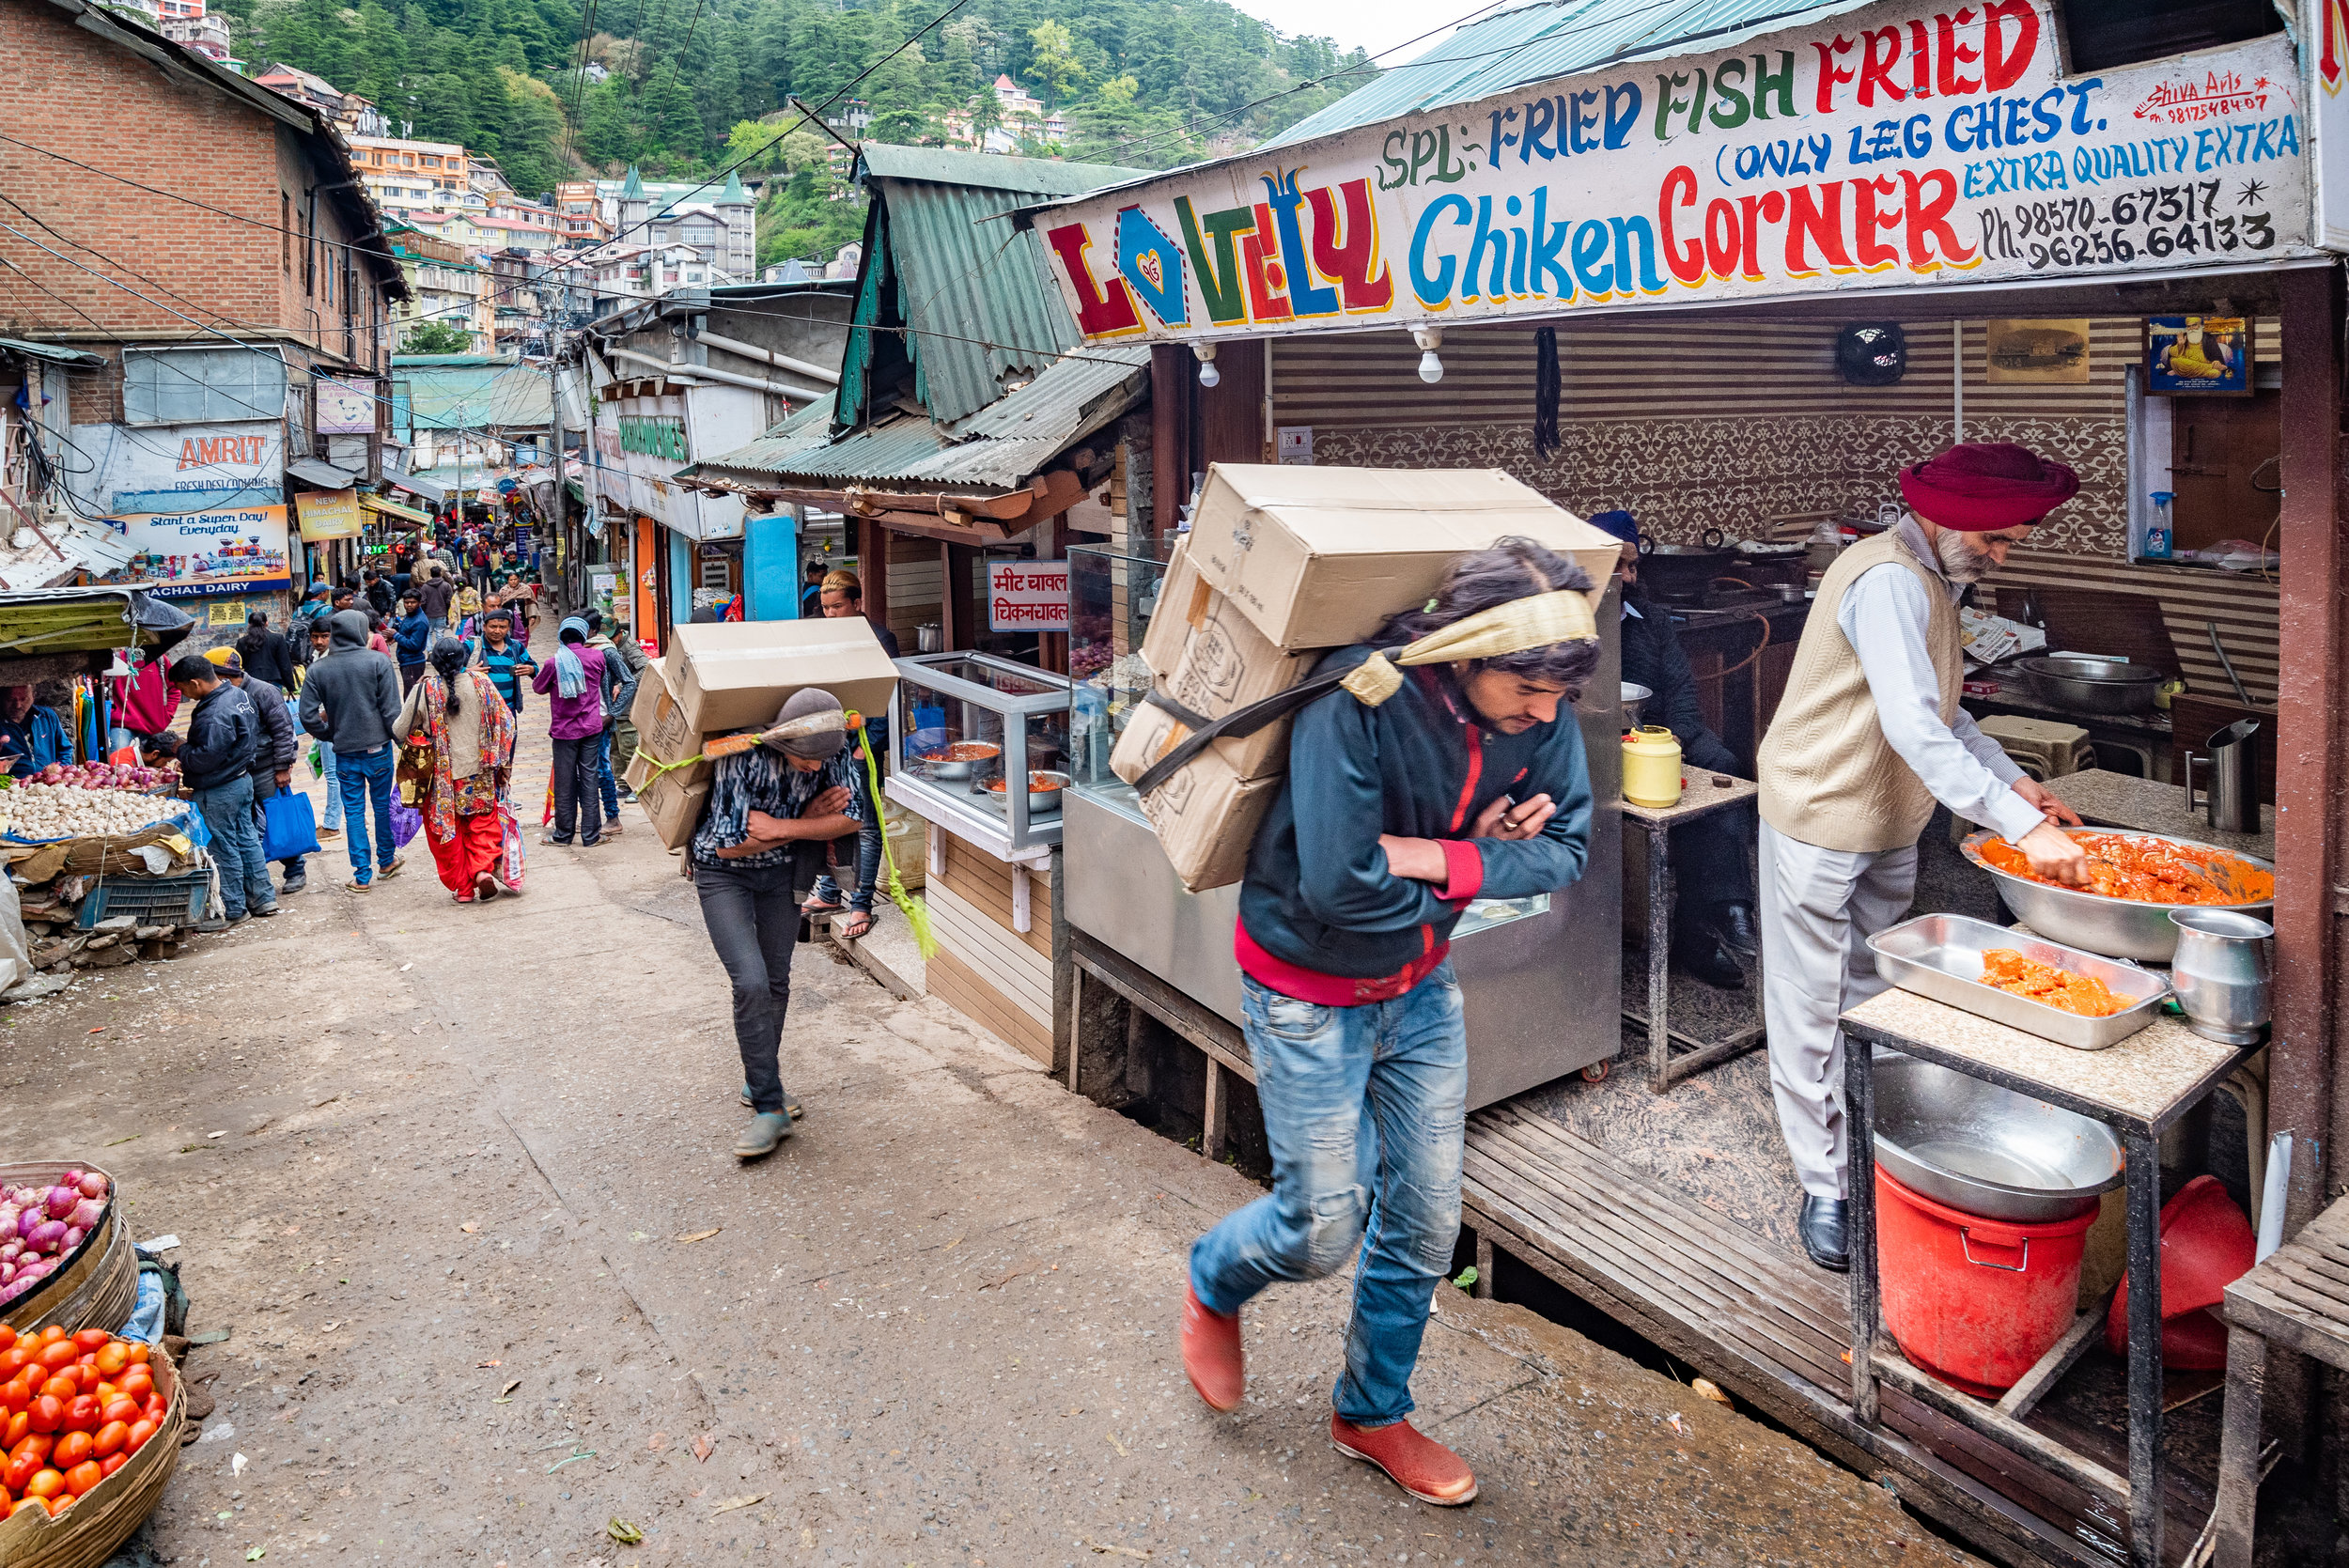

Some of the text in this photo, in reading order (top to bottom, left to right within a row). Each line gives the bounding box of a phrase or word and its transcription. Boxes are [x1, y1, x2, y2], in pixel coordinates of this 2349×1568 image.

[1487, 81, 1642, 169] FRIED
[1655, 49, 1800, 140] FISH
[1811, 0, 2040, 113] FRIED
[1717, 133, 1833, 187] (ONLY
[1848, 113, 1933, 165] LEG
[1964, 114, 2301, 200] EXTRA QUALITY EXTRA
[2015, 178, 2221, 240] 98570-67317
[1047, 165, 1394, 340] LOVELY
[1409, 185, 1670, 312] Chiken
[2027, 211, 2277, 271] 96256-64133
[178, 435, 267, 471] AMRIT
[175, 479, 204, 490] FRESH
[303, 505, 353, 519] HIMACHAL
[315, 495, 337, 505] NEW
[150, 516, 183, 526] Start
[198, 514, 236, 525] Super
[239, 511, 268, 522] Day!
[315, 518, 345, 528] DAIRY
[206, 582, 250, 594] DAIRY
[994, 567, 1068, 591] मीट चावल
